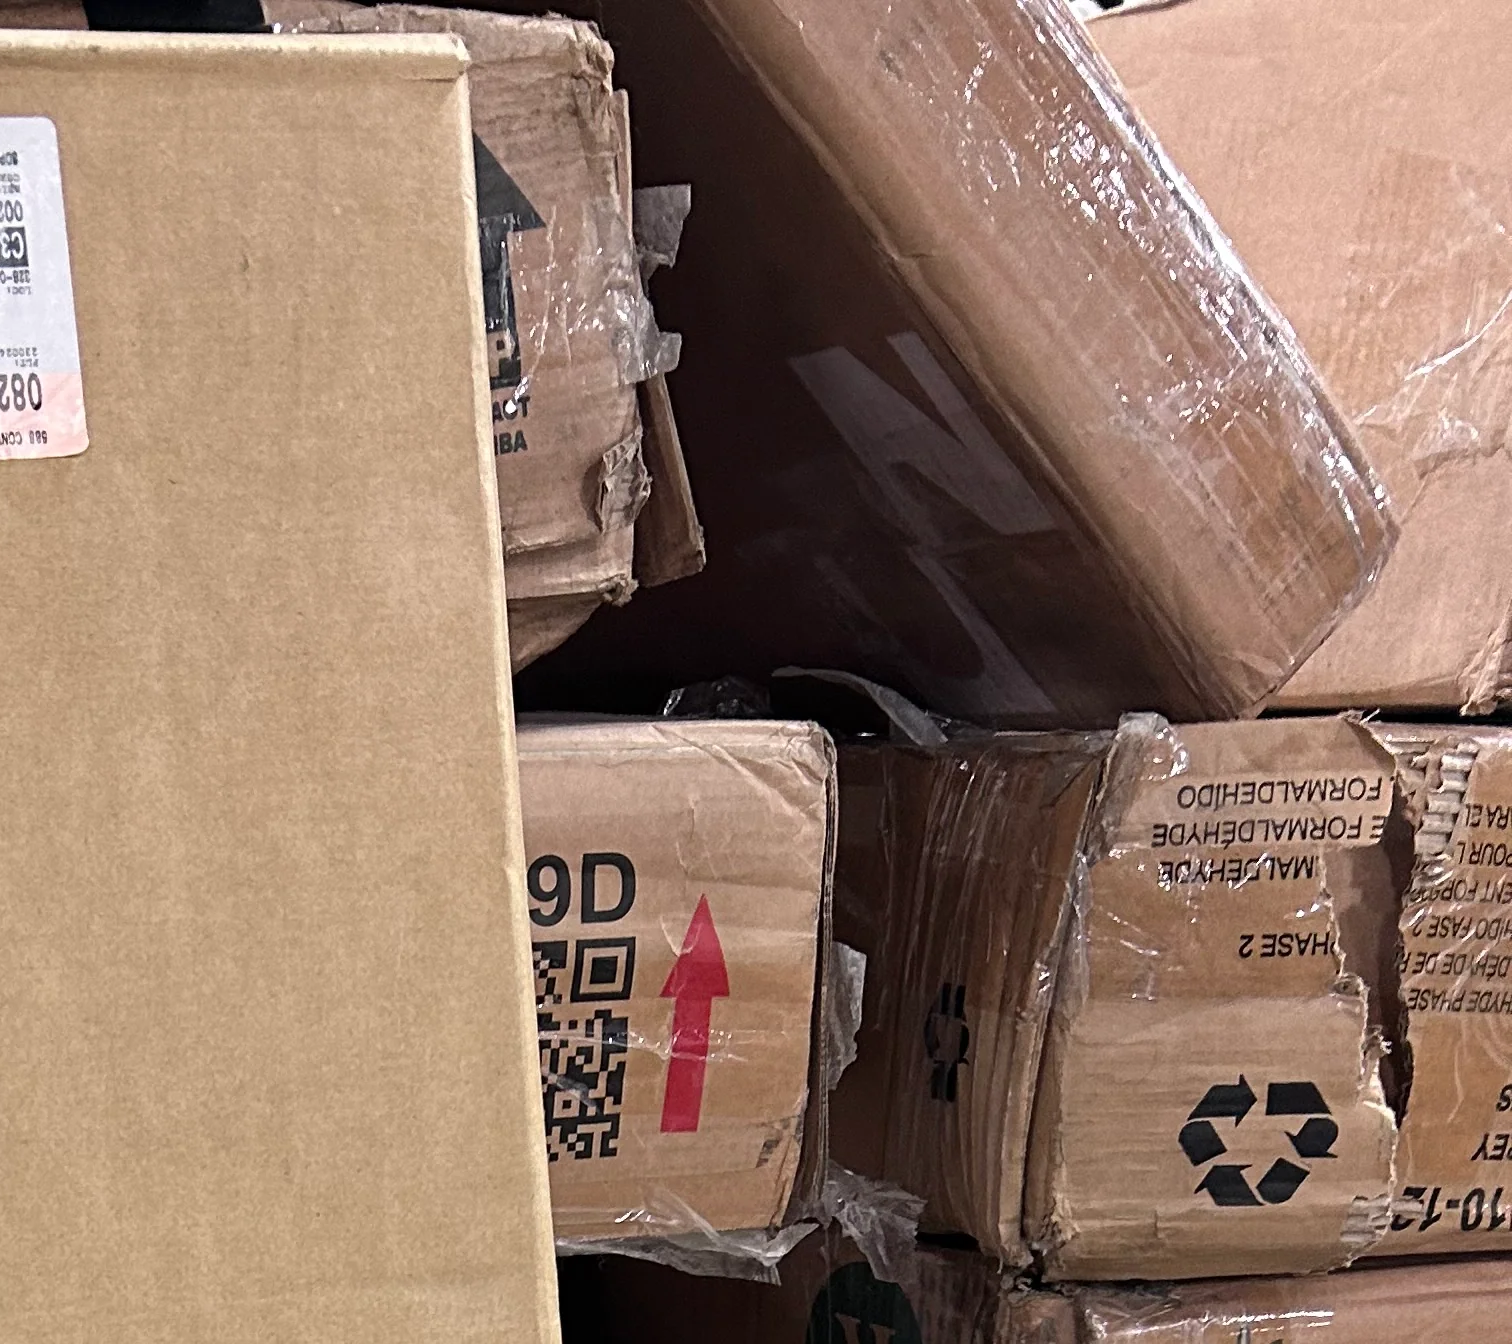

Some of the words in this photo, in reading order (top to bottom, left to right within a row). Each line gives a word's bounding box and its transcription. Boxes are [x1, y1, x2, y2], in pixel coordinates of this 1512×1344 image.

[1177, 777, 1383, 812] FORMALDEHÍDO
[1151, 815, 1362, 850] FORMALDÉHYDE
[1158, 855, 1320, 885] MALDEHYDE
[526, 852, 637, 926] 9D
[1238, 934, 1254, 959] 2
